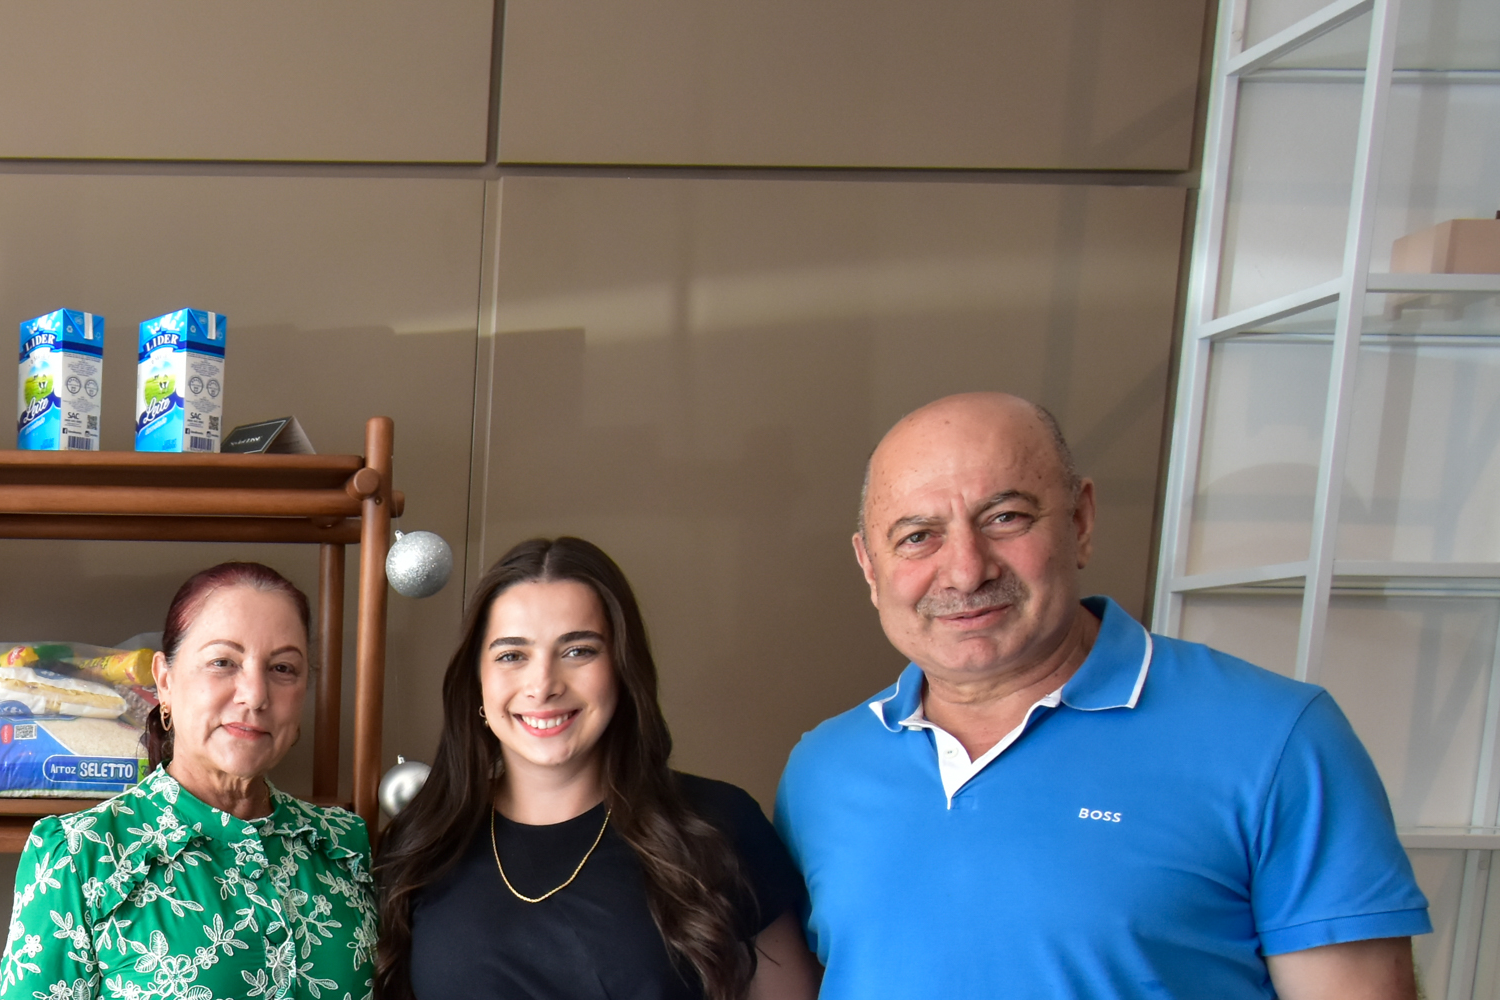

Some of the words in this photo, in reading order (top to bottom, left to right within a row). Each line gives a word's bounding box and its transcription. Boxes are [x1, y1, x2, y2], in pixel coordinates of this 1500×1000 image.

[25, 333, 56, 352] LIDER
[146, 333, 179, 353] LIDER
[67, 411, 80, 420] SAC
[190, 411, 202, 420] SAC
[50, 763, 77, 775] Arroz
[79, 762, 134, 779] SELETTO
[1078, 807, 1122, 823] BOSS
